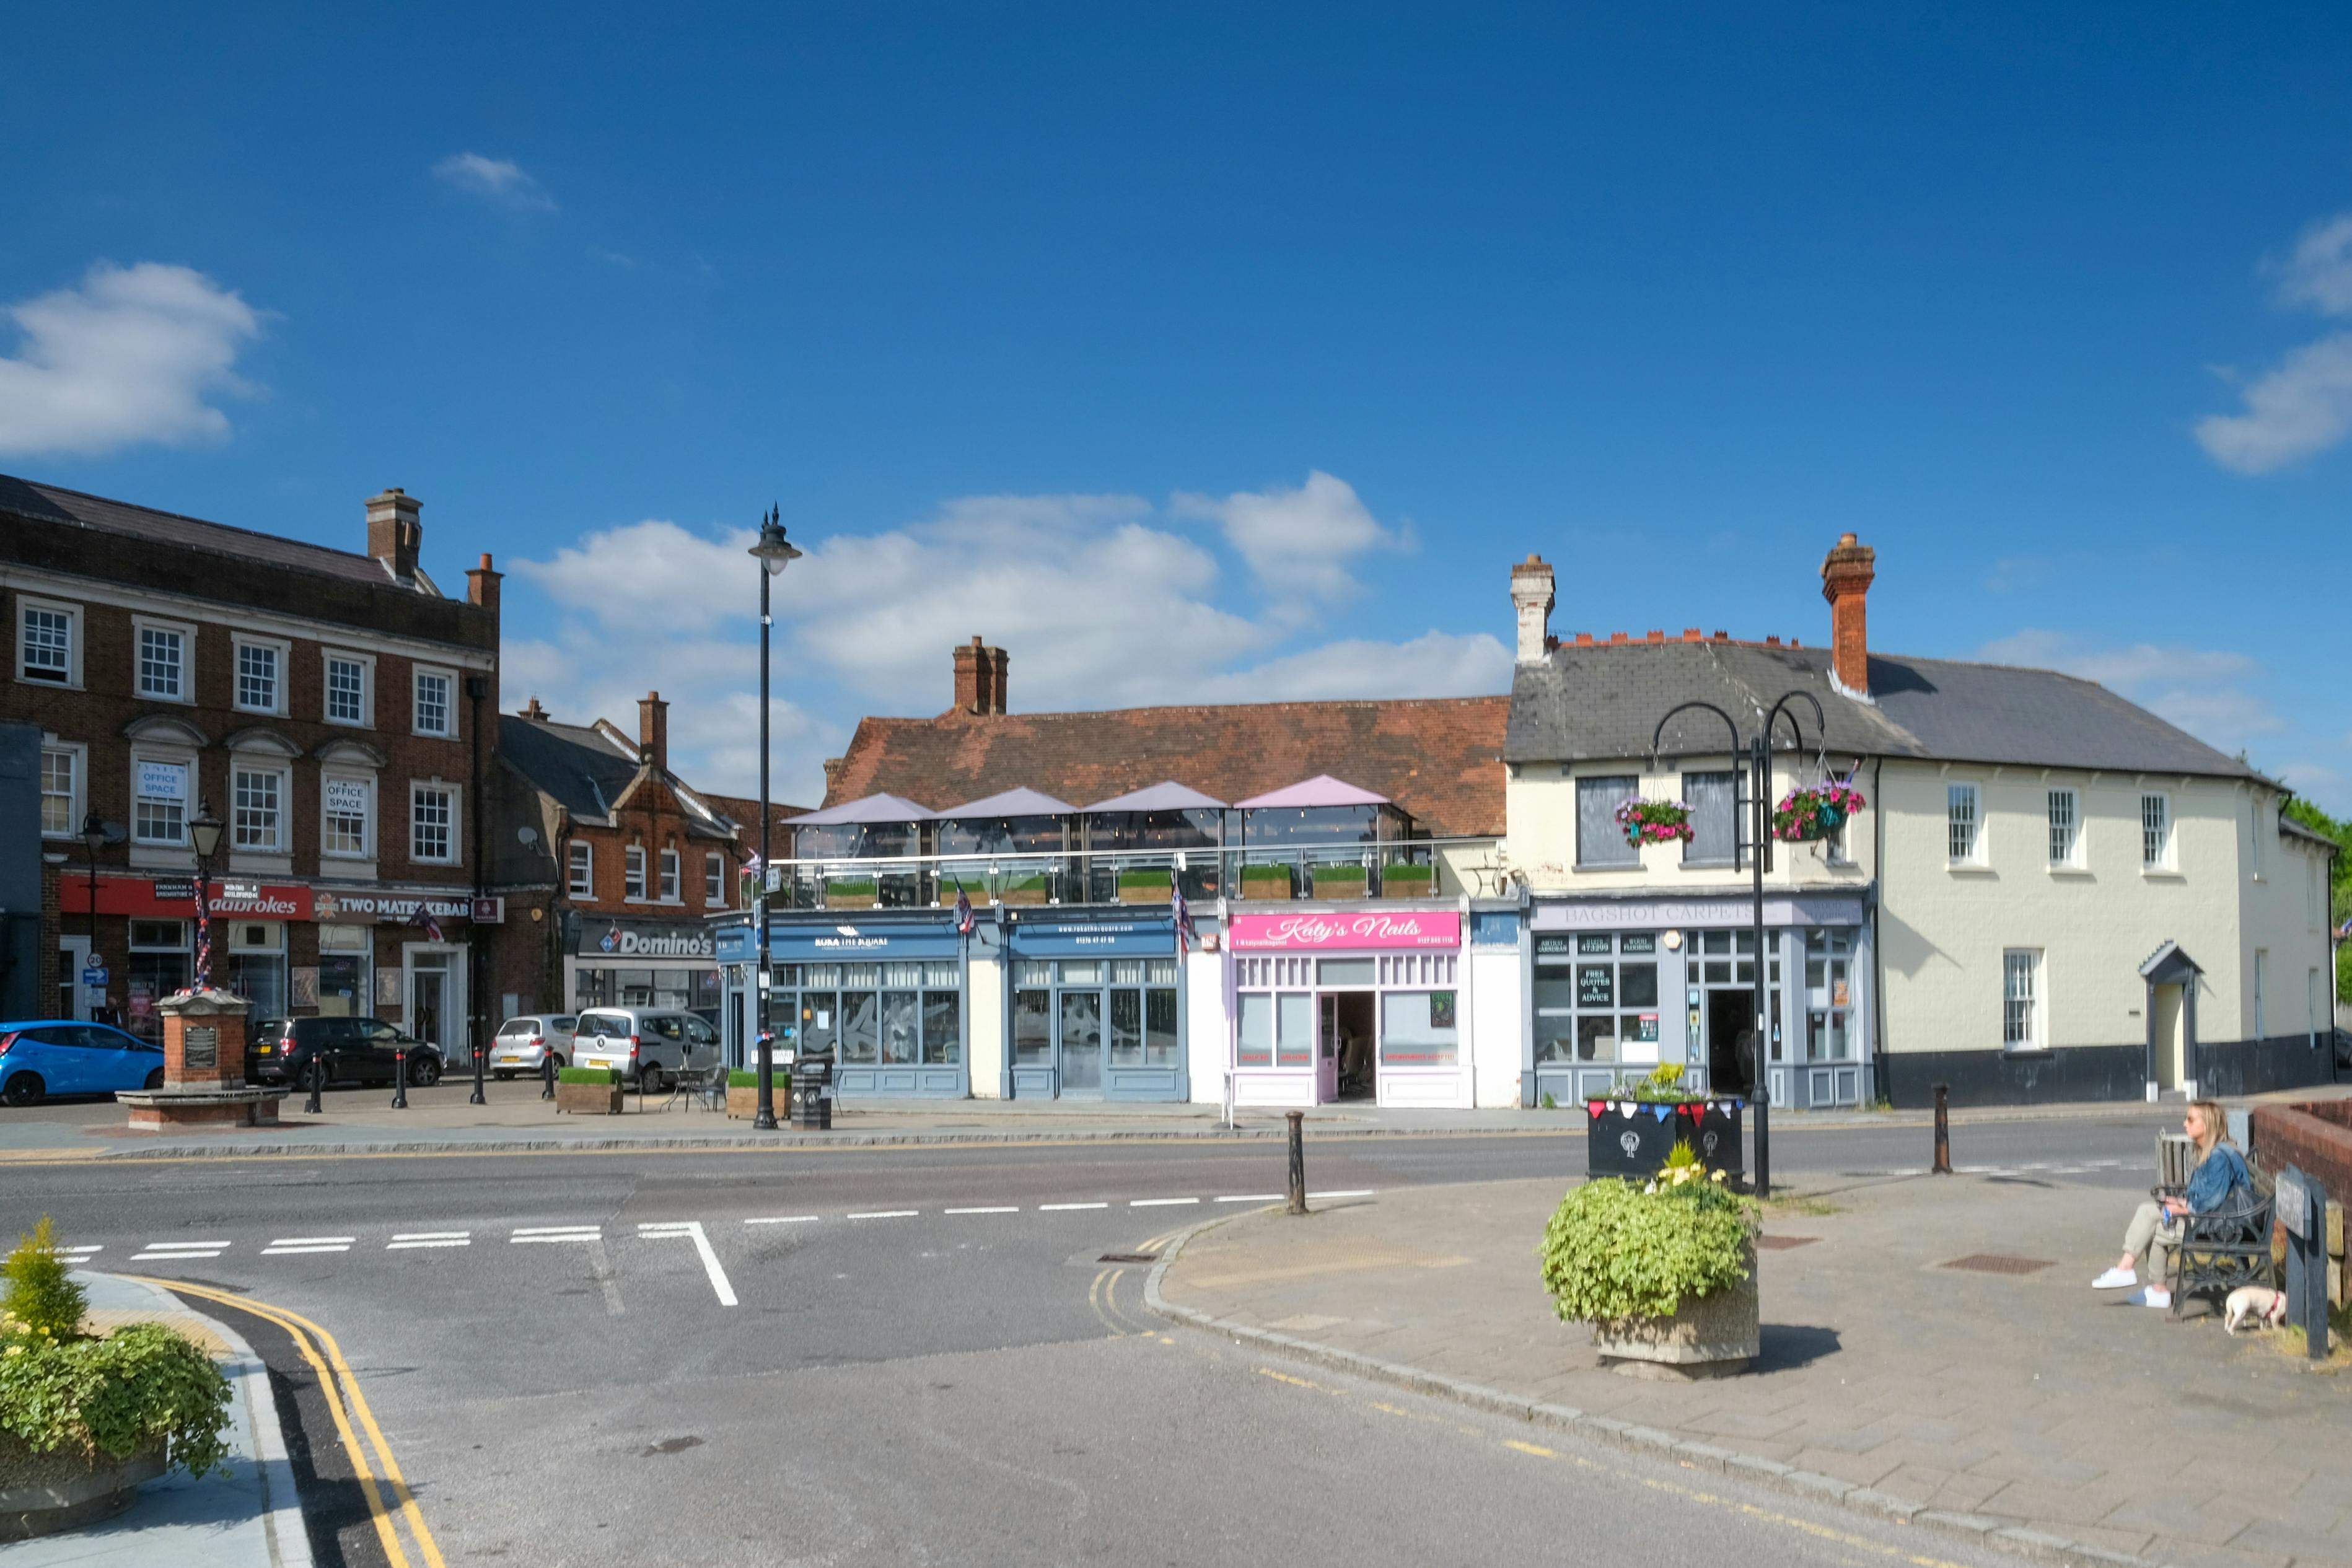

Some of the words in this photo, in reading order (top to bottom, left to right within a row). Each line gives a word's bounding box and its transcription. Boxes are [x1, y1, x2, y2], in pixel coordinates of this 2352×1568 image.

[144, 773, 177, 783] OFFICE
[145, 784, 176, 794] SPACE
[328, 786, 364, 799] OFFICE
[329, 798, 362, 809] SPACE
[208, 895, 297, 914] adbrokes
[340, 898, 374, 913] TWO
[426, 903, 468, 917] KEBAB
[1565, 907, 1659, 923] BAGSHOT
[1666, 903, 1755, 920] CARPETS
[1266, 917, 1348, 943] Katy's
[1352, 916, 1421, 939] Nails
[620, 931, 712, 955] Domino's
[1586, 970, 1605, 978] FREE
[1581, 977, 1610, 986] QUOTES
[1582, 993, 1609, 1002] ADVICE
